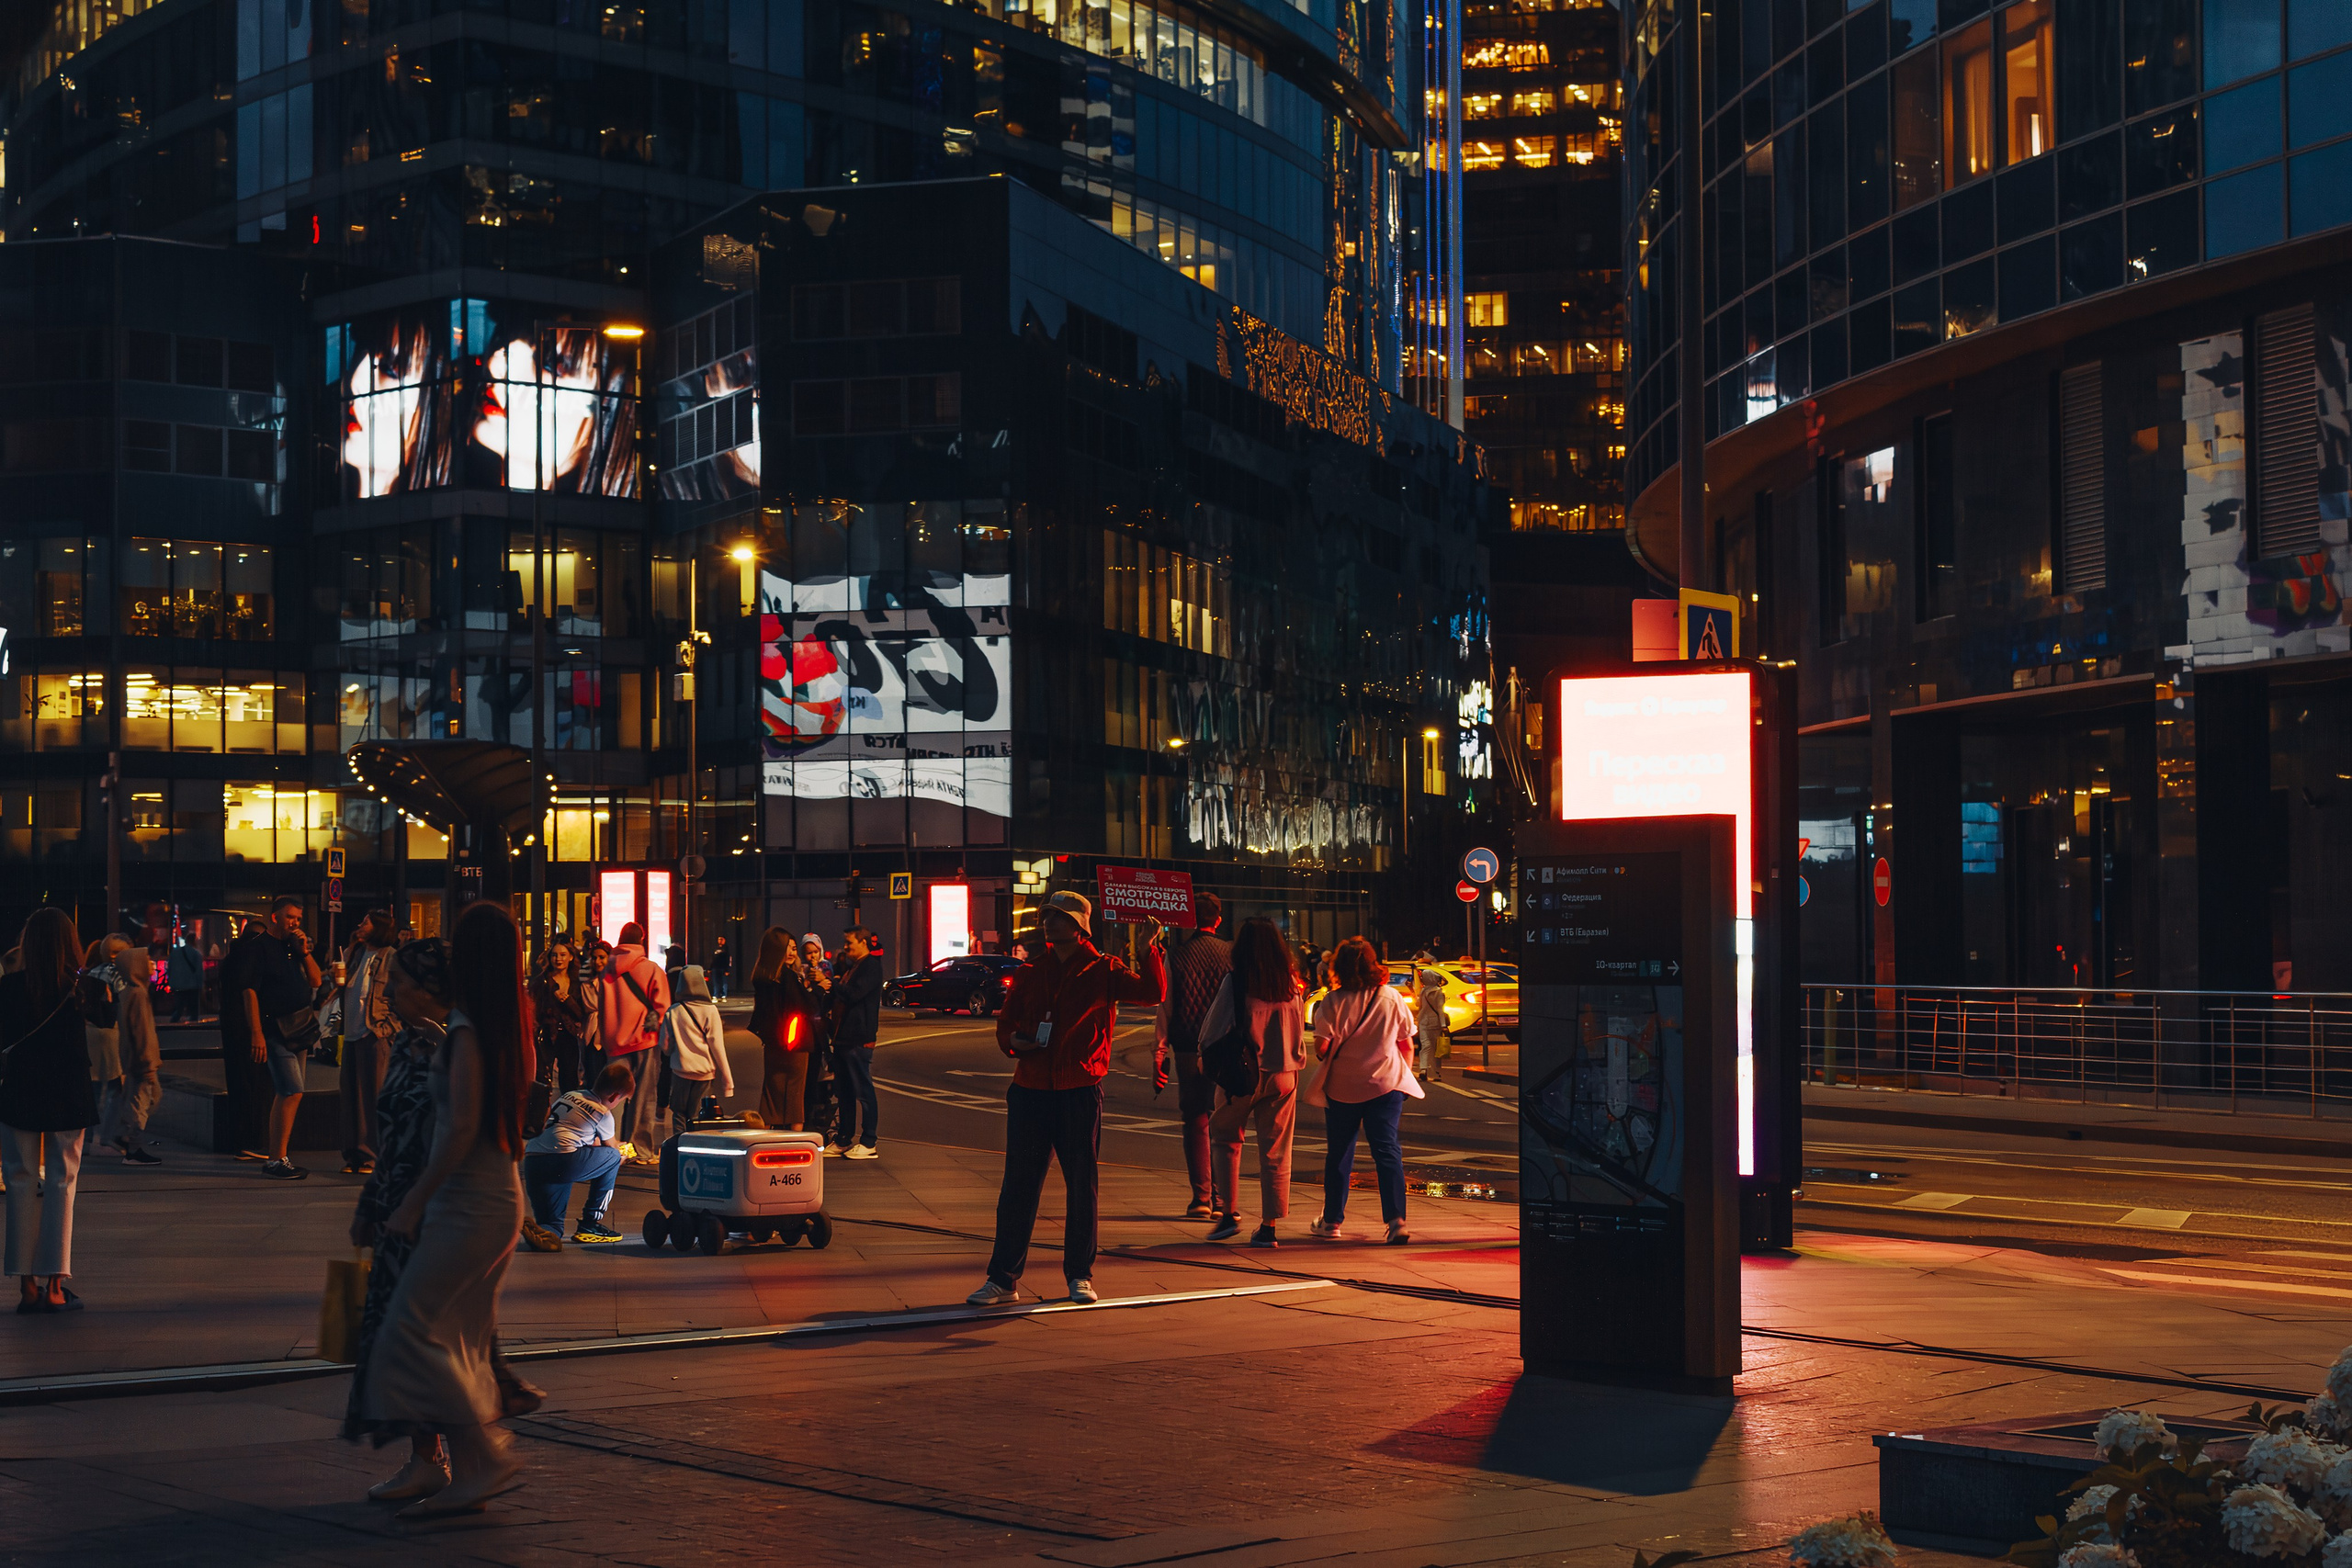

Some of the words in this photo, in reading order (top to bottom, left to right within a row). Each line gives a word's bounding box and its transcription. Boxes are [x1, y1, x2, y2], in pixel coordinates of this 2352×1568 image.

[1104, 887, 1188, 902] СМОТРОВАЯ
[1562, 893, 1602, 903] Федерация
[1105, 897, 1189, 912] ПЛОЩАДКА
[770, 1173, 802, 1187] A-466
